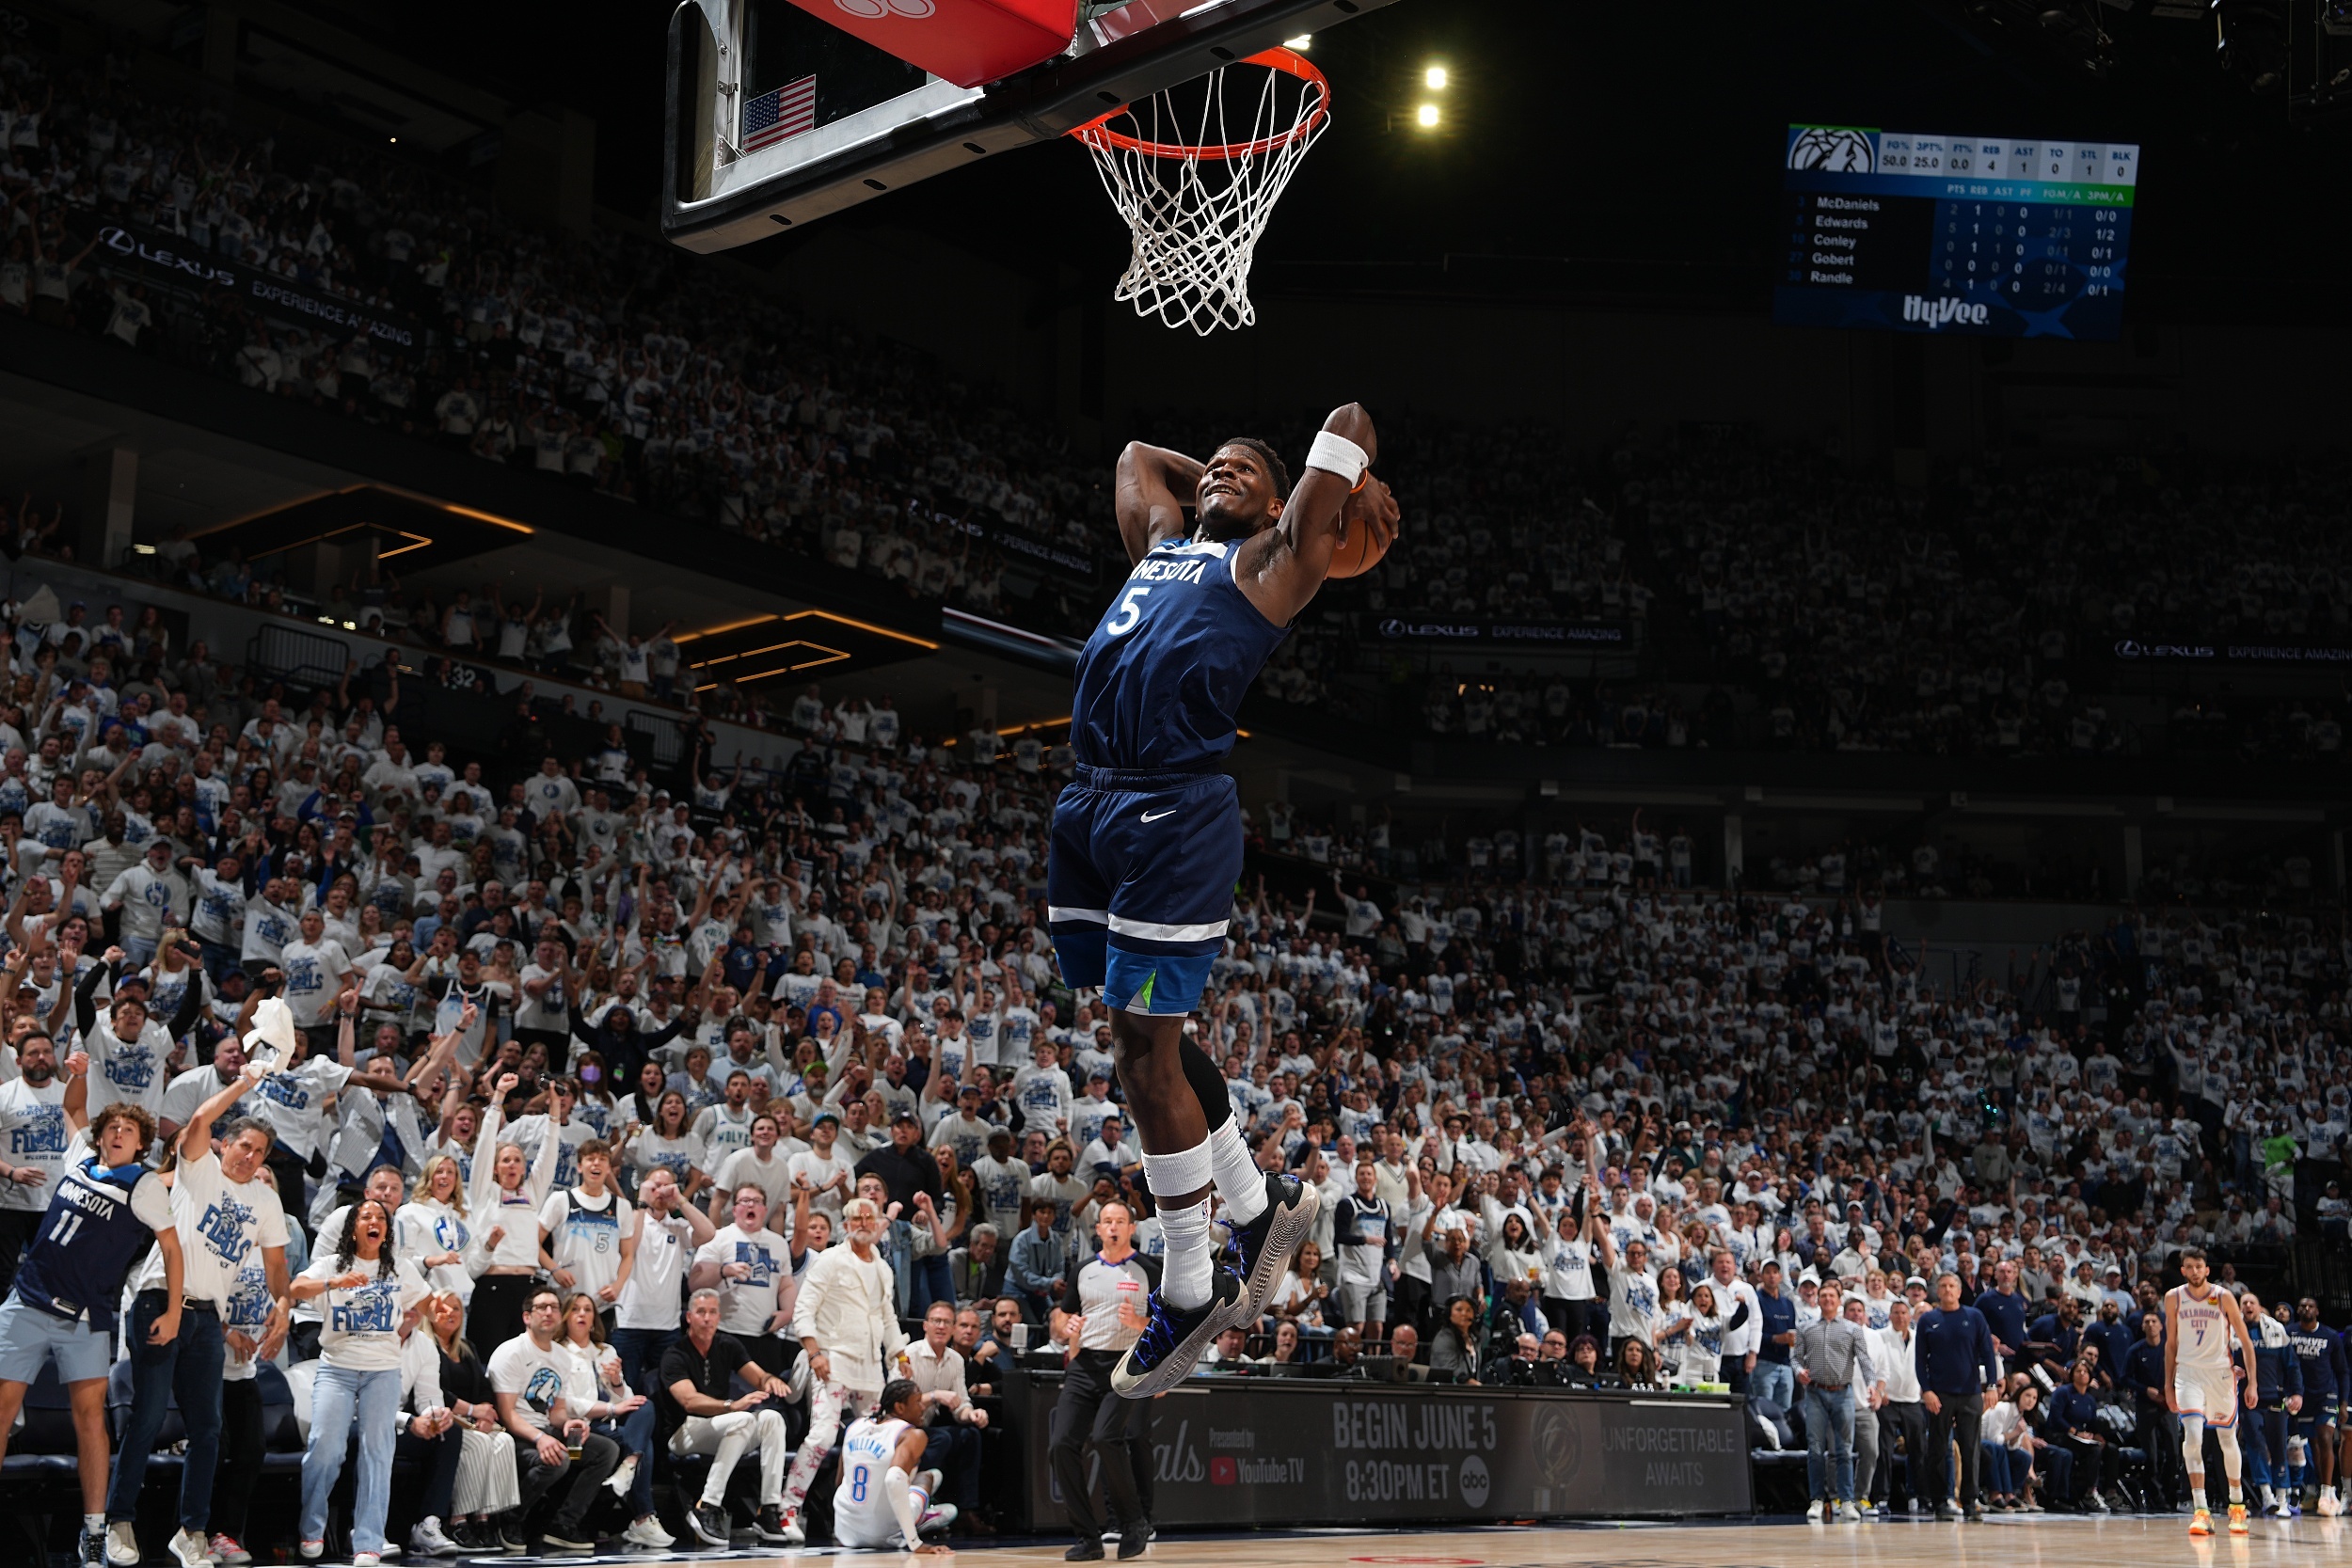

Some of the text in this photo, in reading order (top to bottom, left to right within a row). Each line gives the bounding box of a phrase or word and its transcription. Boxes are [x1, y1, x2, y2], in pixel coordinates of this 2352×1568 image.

[1886, 140, 2132, 161] FG% 3PT% FT% REB AST TO STL BLK
[1882, 155, 2124, 177] 50.0 25.0 0.0 4 1 0 1 0
[1947, 183, 2125, 202] PTS REB AST PF FGM/A 3PM/A
[1817, 196, 1881, 212] McDaniels
[1949, 203, 1958, 216] 2
[1974, 203, 1981, 216] 1
[1996, 205, 2005, 217] 0
[2020, 206, 2028, 219] 0
[2053, 207, 2073, 220] 1/1
[2094, 209, 2117, 223] 0/0
[1815, 214, 1869, 230] Edwards
[1972, 222, 1979, 235] 1
[1994, 224, 2003, 236] 0
[2017, 225, 2026, 238] 0
[2048, 226, 2072, 239] 2/3
[2095, 228, 2115, 242] 1/2
[1813, 232, 1857, 250] Conley
[1946, 240, 1955, 253] 0
[1970, 241, 1978, 254] 1
[2016, 243, 2025, 256] 0
[2046, 245, 2069, 257] 0/1
[2091, 246, 2112, 260] 0/1
[1811, 251, 1855, 266] Gobert
[1944, 259, 1952, 271] 0
[1967, 259, 1977, 273] 0
[1991, 261, 1999, 273] 0
[2014, 261, 2023, 275] 0
[2044, 262, 2067, 277] 0/1
[2090, 264, 2111, 278] 0/0
[138, 242, 413, 347] LEXUS EXPERIENCE AAZING
[1810, 270, 1853, 285] Randle
[1967, 277, 1974, 291] 1
[1990, 278, 1998, 292] 0
[2011, 280, 2021, 293] 0
[2042, 281, 2066, 294] 2/4
[2087, 283, 2108, 297] 0/1
[1106, 586, 1153, 637] 5
[1407, 624, 1623, 641] LEXUS EXPERIENCE AMAZING
[2142, 643, 2215, 657] LEXUS
[2228, 645, 2302, 660] EXPERIENCE
[452, 664, 477, 688] 32
[717, 1130, 753, 1147] WOLVE
[48, 1209, 85, 1247] 11
[595, 1232, 610, 1254] 5
[2179, 1307, 2220, 1321] OKLAHOMA
[2191, 1319, 2208, 1328] CITY
[2196, 1329, 2204, 1346] 7
[2291, 1336, 2328, 1350] WOLVES
[2296, 1344, 2321, 1357] BACK
[1333, 1402, 1497, 1451] BEGIN JUNE 5
[848, 1437, 886, 1460] WILLIAMS
[1209, 1428, 1246, 1449] Presented
[1602, 1426, 1735, 1453] UNFORGETTABLE
[1237, 1457, 1305, 1484] YouTube TV
[1346, 1459, 1450, 1502] 8:30PM ET
[1462, 1470, 1487, 1489] abc
[1645, 1461, 1705, 1487] AWAITS
[852, 1464, 870, 1504] 8
